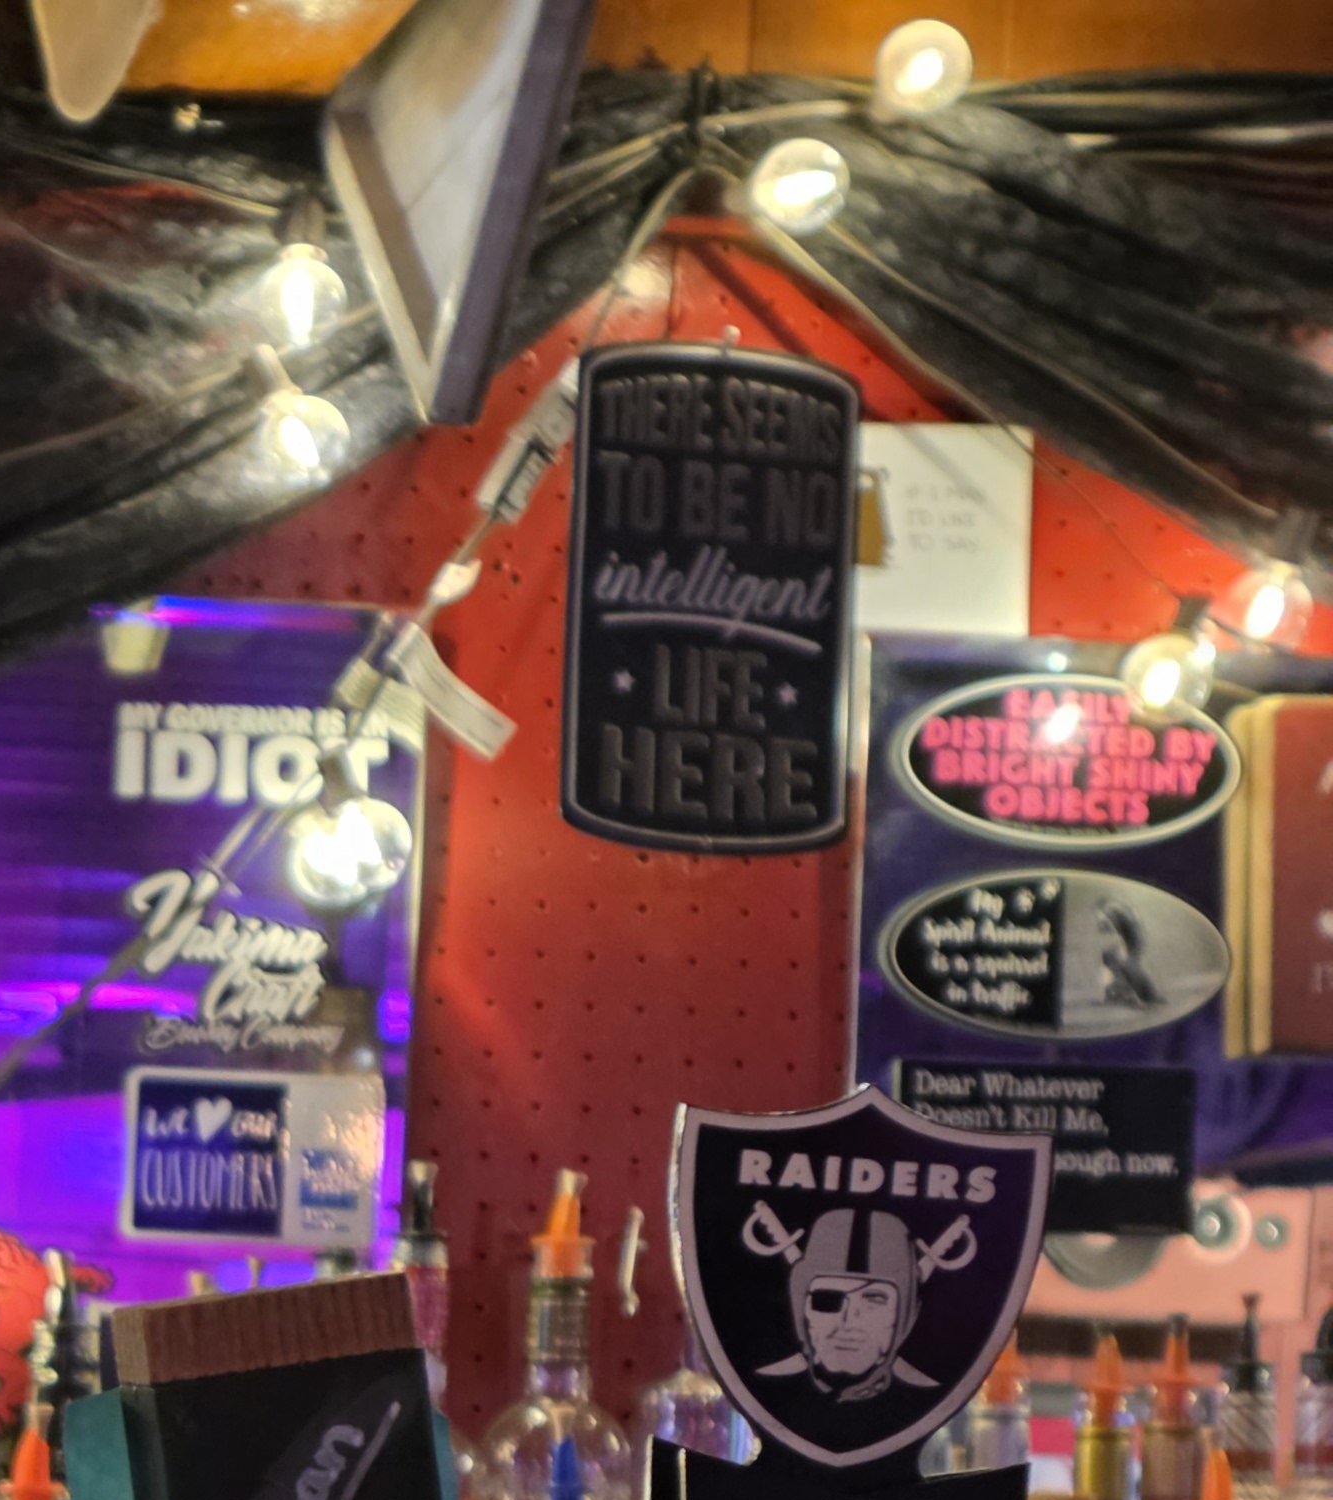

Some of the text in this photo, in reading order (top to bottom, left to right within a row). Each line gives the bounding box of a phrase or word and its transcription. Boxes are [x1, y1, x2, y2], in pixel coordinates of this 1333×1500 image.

[597, 370, 713, 452] THERE
[595, 449, 836, 548] TO BE NO
[593, 544, 832, 623] intelligent
[653, 642, 768, 735] LIFE
[1005, 688, 1131, 724] EASILY
[116, 730, 389, 806] IDIOT
[932, 749, 1204, 797] BRIGHT SHINY
[1163, 726, 1217, 764] BY
[596, 722, 819, 827] HERE
[985, 783, 1150, 825] OBJECTS
[915, 1068, 1106, 1101] Dear Whatever
[915, 1101, 1008, 1130] Doesn't
[1013, 1103, 1058, 1132] Kill
[141, 1149, 279, 1211] CUSTOMERS
[737, 1148, 998, 1204] RAIDERS
[1053, 1148, 1121, 1177] nough
